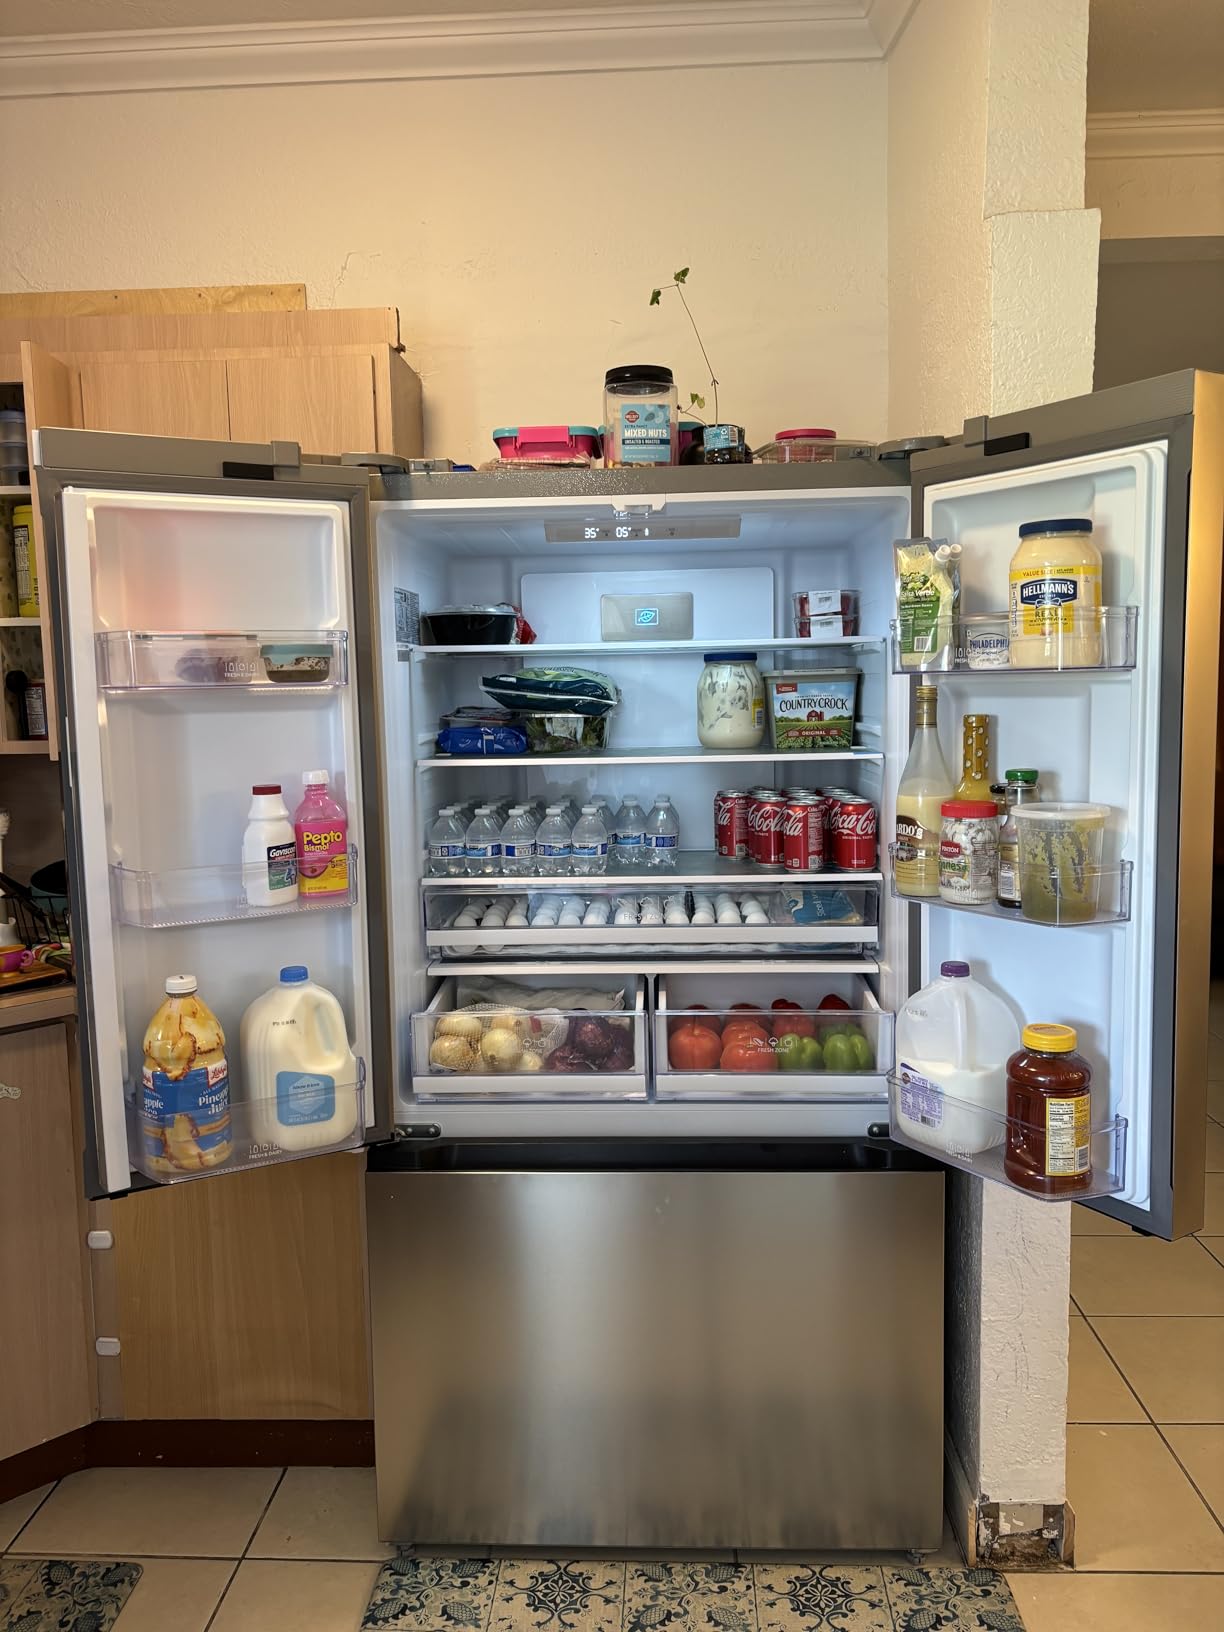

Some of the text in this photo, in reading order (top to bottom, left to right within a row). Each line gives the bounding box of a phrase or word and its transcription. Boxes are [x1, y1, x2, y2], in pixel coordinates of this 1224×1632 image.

[624, 428, 667, 438] MIXED NUTS
[1023, 581, 1074, 598] HELLMANN'S
[1035, 608, 1058, 618] REAL
[779, 697, 849, 713] COUNTRY CROCK
[302, 830, 343, 846] Pepto
[304, 844, 330, 852] Bismol
